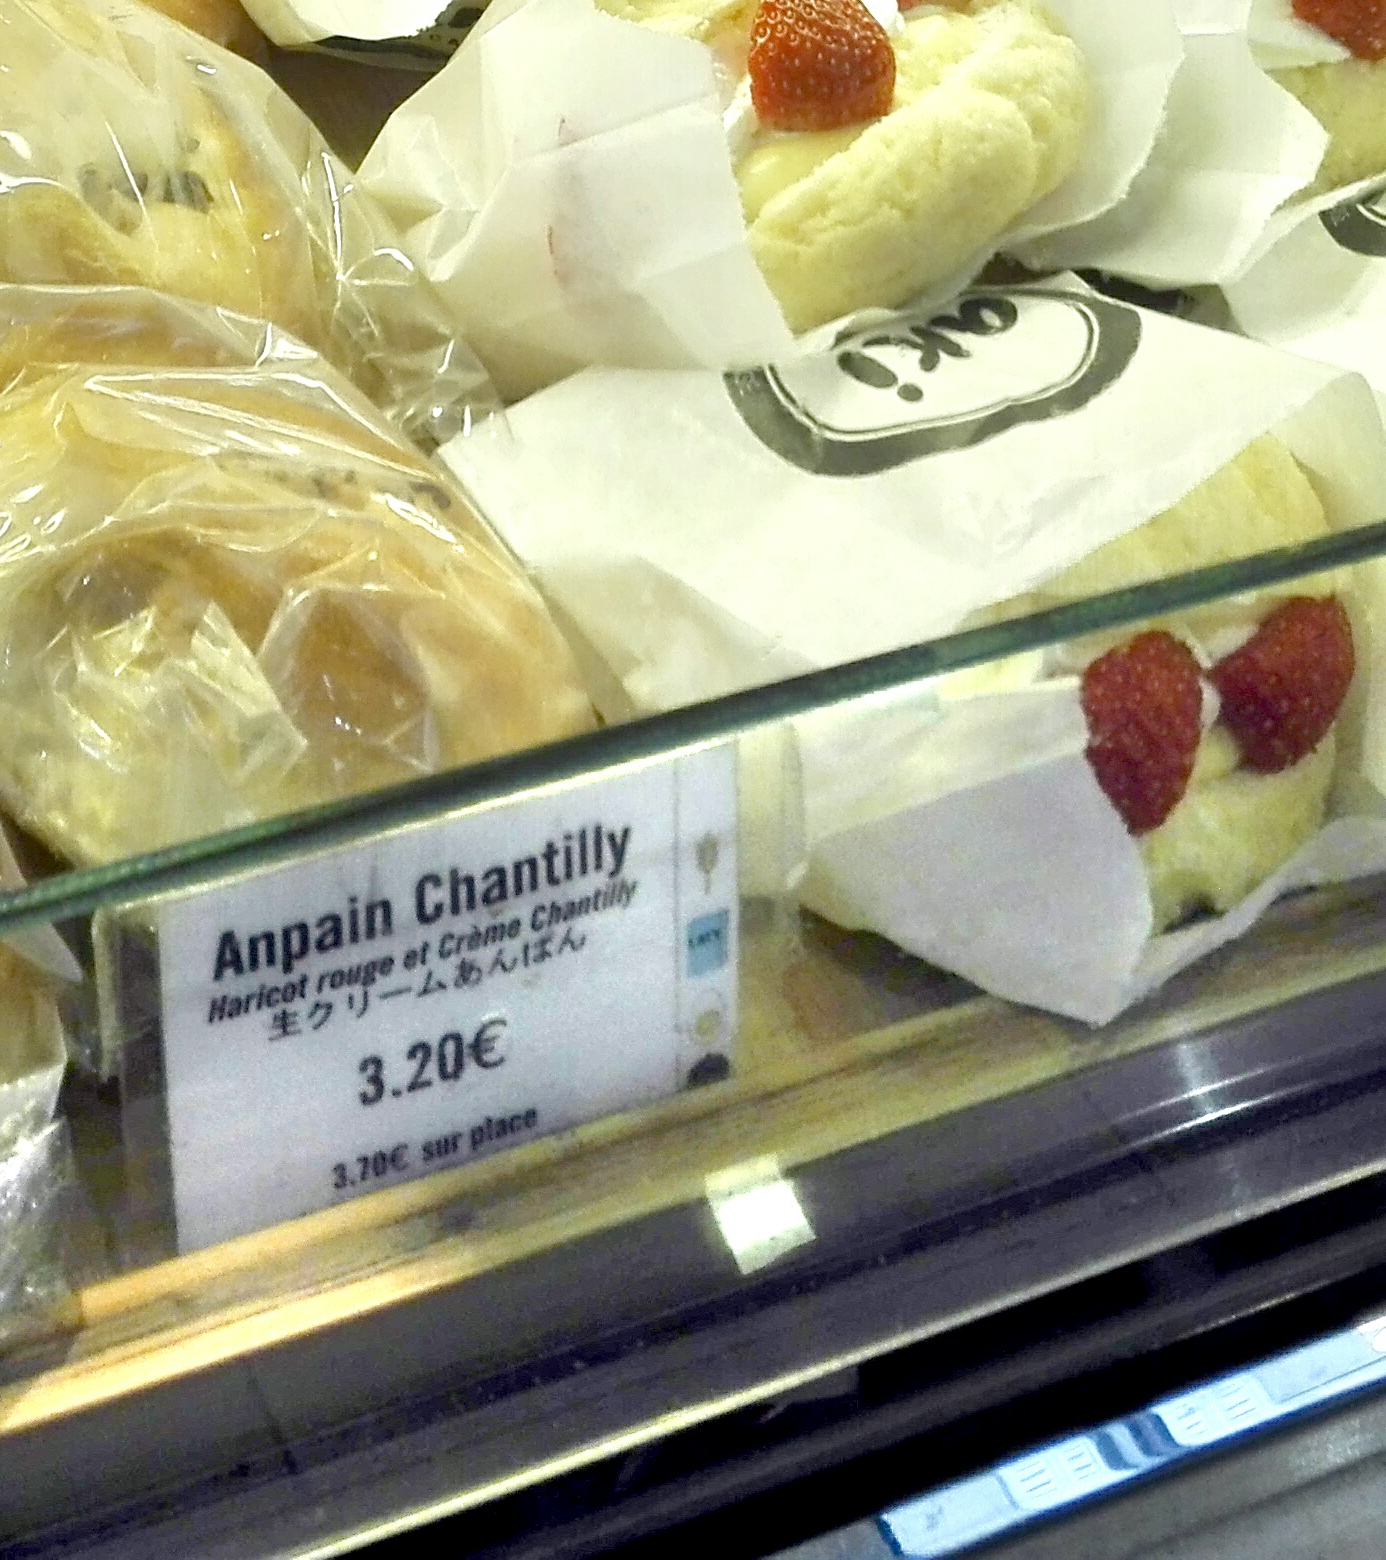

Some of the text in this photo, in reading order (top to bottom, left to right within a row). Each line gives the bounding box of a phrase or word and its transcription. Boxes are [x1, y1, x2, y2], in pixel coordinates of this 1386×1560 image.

[207, 876, 638, 1026] Haricot rouge et Crème Chantilly
[213, 822, 631, 981] Anpain Chantilly
[358, 1019, 508, 1107] 3.20€
[332, 1106, 539, 1192] 3.70€ sur place
